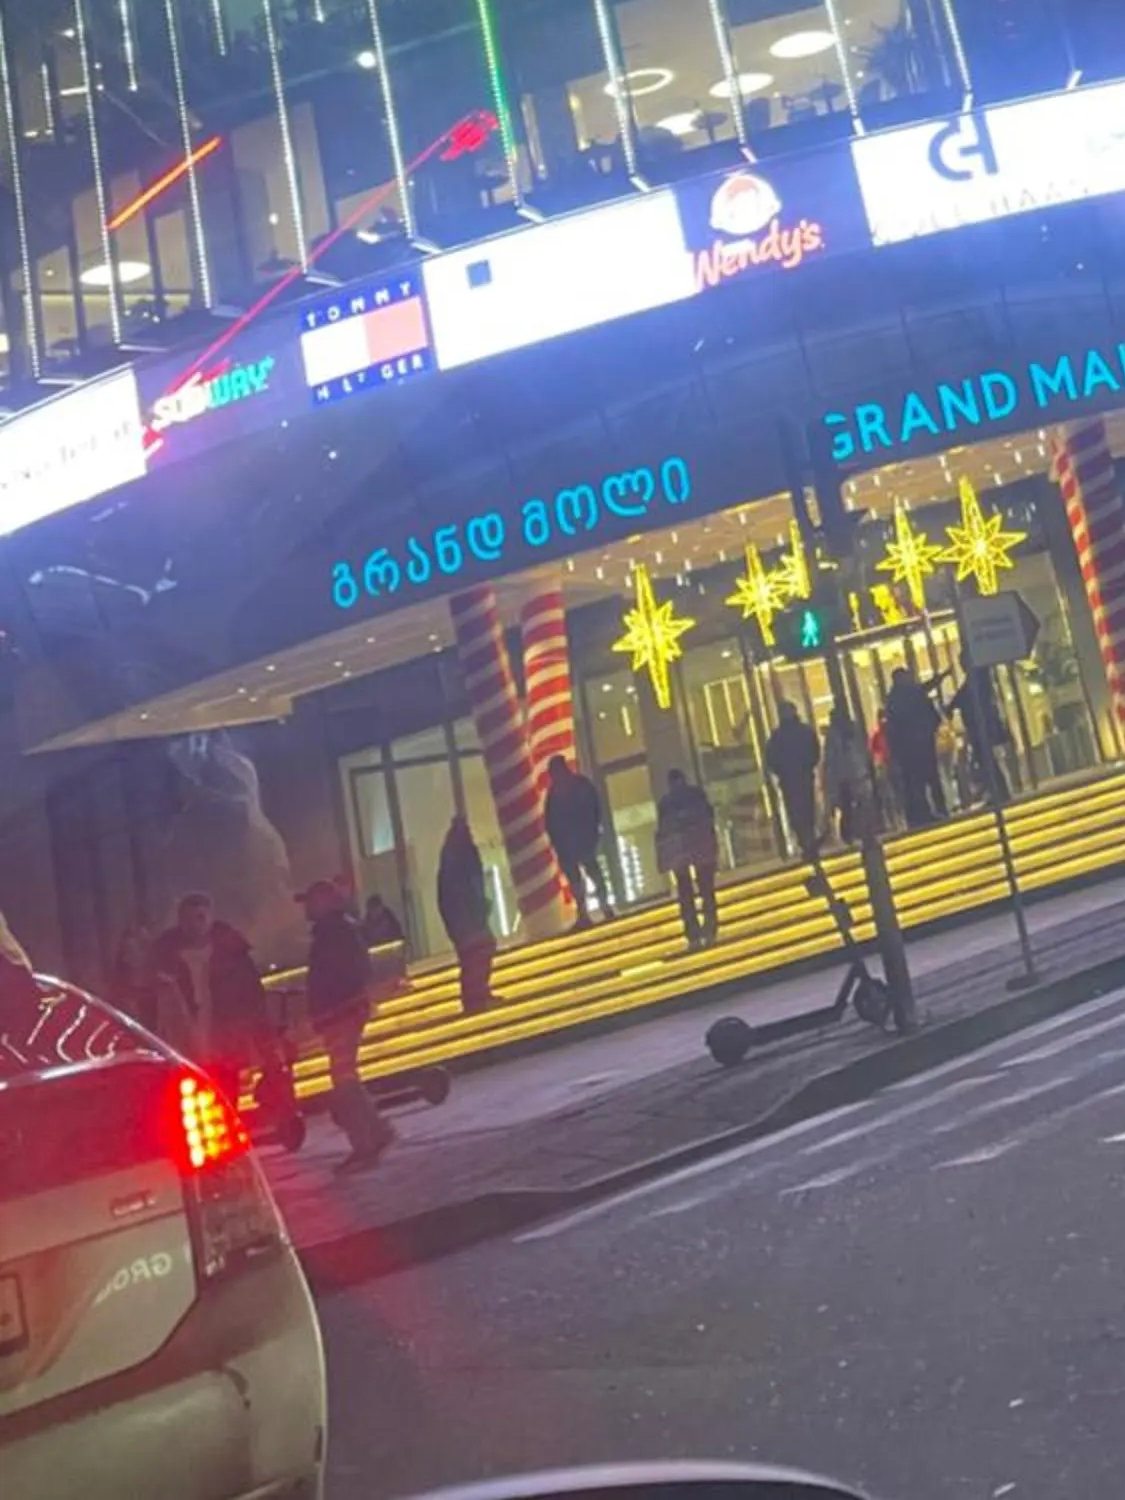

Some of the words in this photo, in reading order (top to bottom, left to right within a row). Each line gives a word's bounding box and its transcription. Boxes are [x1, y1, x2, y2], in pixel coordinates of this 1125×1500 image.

[695, 218, 822, 292] Wendy's
[307, 281, 410, 327] TOMMY
[824, 372, 1018, 461] GRAND
[332, 512, 505, 608] გრანდ
[521, 456, 692, 547] მოლი
